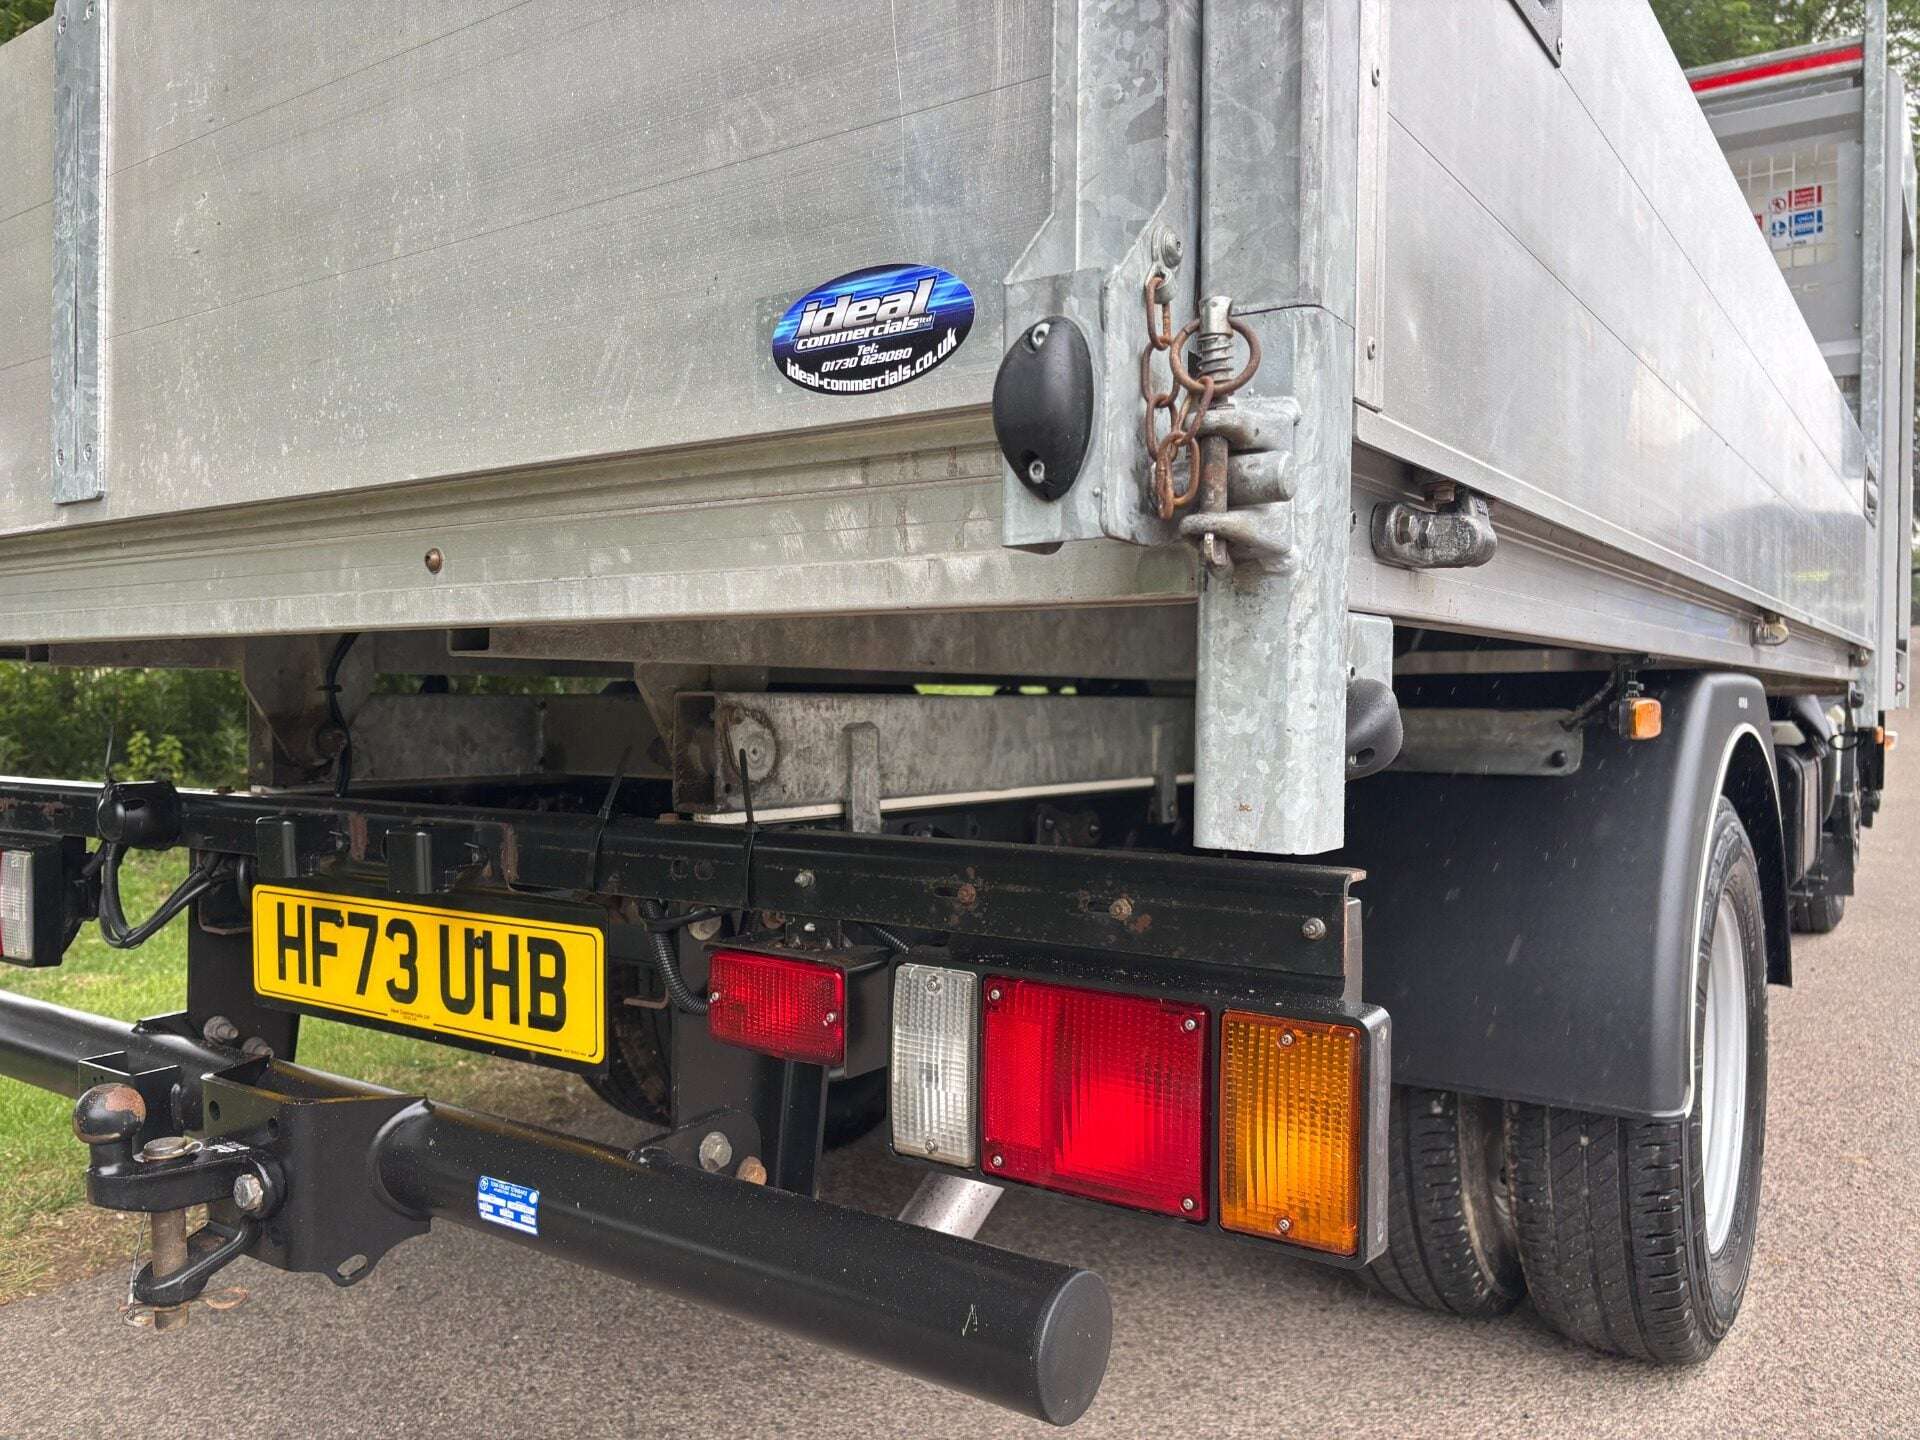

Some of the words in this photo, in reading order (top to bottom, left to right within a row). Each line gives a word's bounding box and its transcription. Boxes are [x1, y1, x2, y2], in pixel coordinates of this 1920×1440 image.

[797, 278, 936, 337] ideal
[796, 317, 920, 350] commercials
[857, 344, 879, 356] Tel:
[786, 327, 958, 392] ideal-commercials.co.uk
[821, 355, 858, 373] 01730
[860, 347, 913, 367] 829080
[277, 901, 419, 1004] HF73
[439, 924, 567, 1033] UHB
